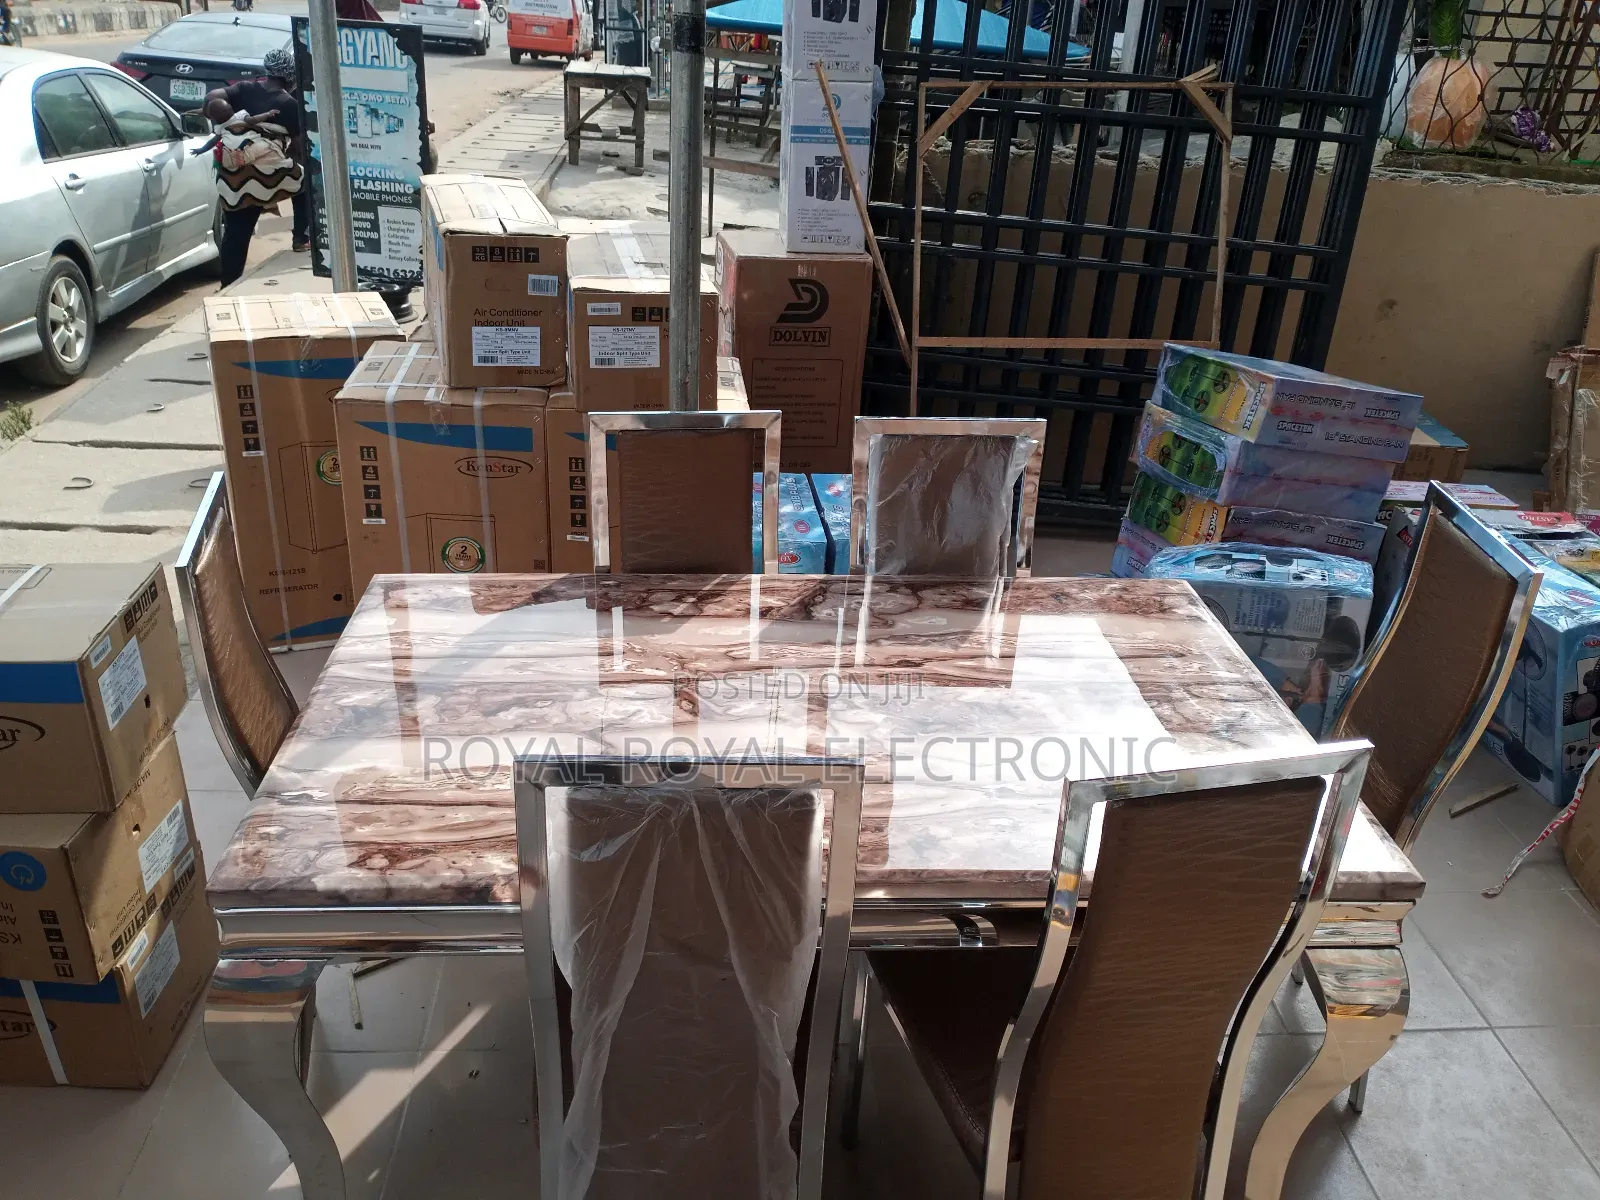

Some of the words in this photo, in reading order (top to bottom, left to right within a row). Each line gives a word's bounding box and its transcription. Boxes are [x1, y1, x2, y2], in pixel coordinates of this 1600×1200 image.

[349, 165, 404, 180] LOCKING
[354, 179, 414, 194] FLASHING
[352, 192, 380, 201] MOBILE
[381, 194, 413, 204] PHONES
[352, 211, 375, 220] MSUNG
[354, 240, 365, 248] TEL
[473, 308, 487, 316] Air
[489, 308, 543, 317] Conditioner
[474, 319, 504, 327] Indoor
[506, 319, 526, 327] Unit
[773, 330, 828, 343] DOLVIN
[1275, 392, 1298, 403] FAN
[1299, 395, 1342, 409] STANDING
[1363, 407, 1401, 420] SPACETEK
[1276, 421, 1315, 434] SPACETEK
[1339, 432, 1384, 446] STANDING
[1384, 439, 1405, 449] FAN
[574, 476, 582, 485] 4
[1326, 533, 1365, 550] SPACETEK
[460, 545, 468, 555] 2
[259, 583, 319, 595] REFRGERATOR
